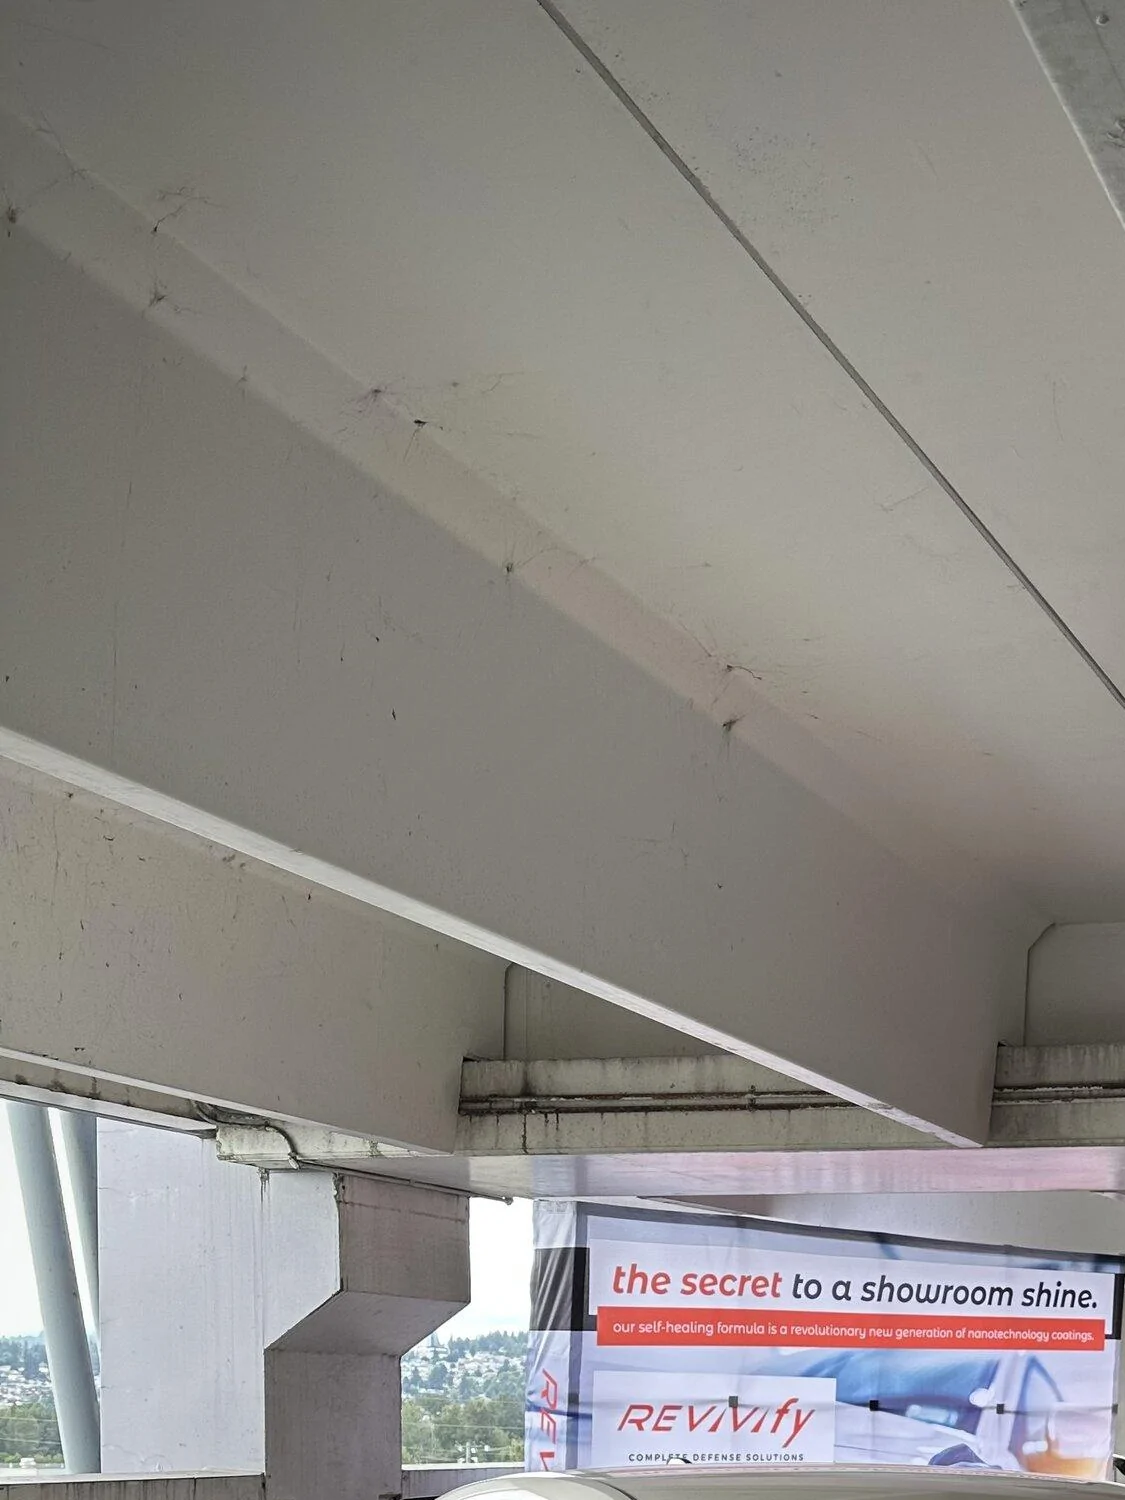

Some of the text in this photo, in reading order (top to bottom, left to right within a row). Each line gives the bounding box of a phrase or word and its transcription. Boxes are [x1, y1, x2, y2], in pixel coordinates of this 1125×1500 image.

[612, 1263, 1098, 1309] the secret to a showroom shine.
[612, 1320, 1095, 1343] our self-healing formula is a revolutionary new generation of nanotechnology coatings.
[692, 1453, 742, 1462] DEFENSE
[746, 1453, 804, 1462] SOLUTIONS
